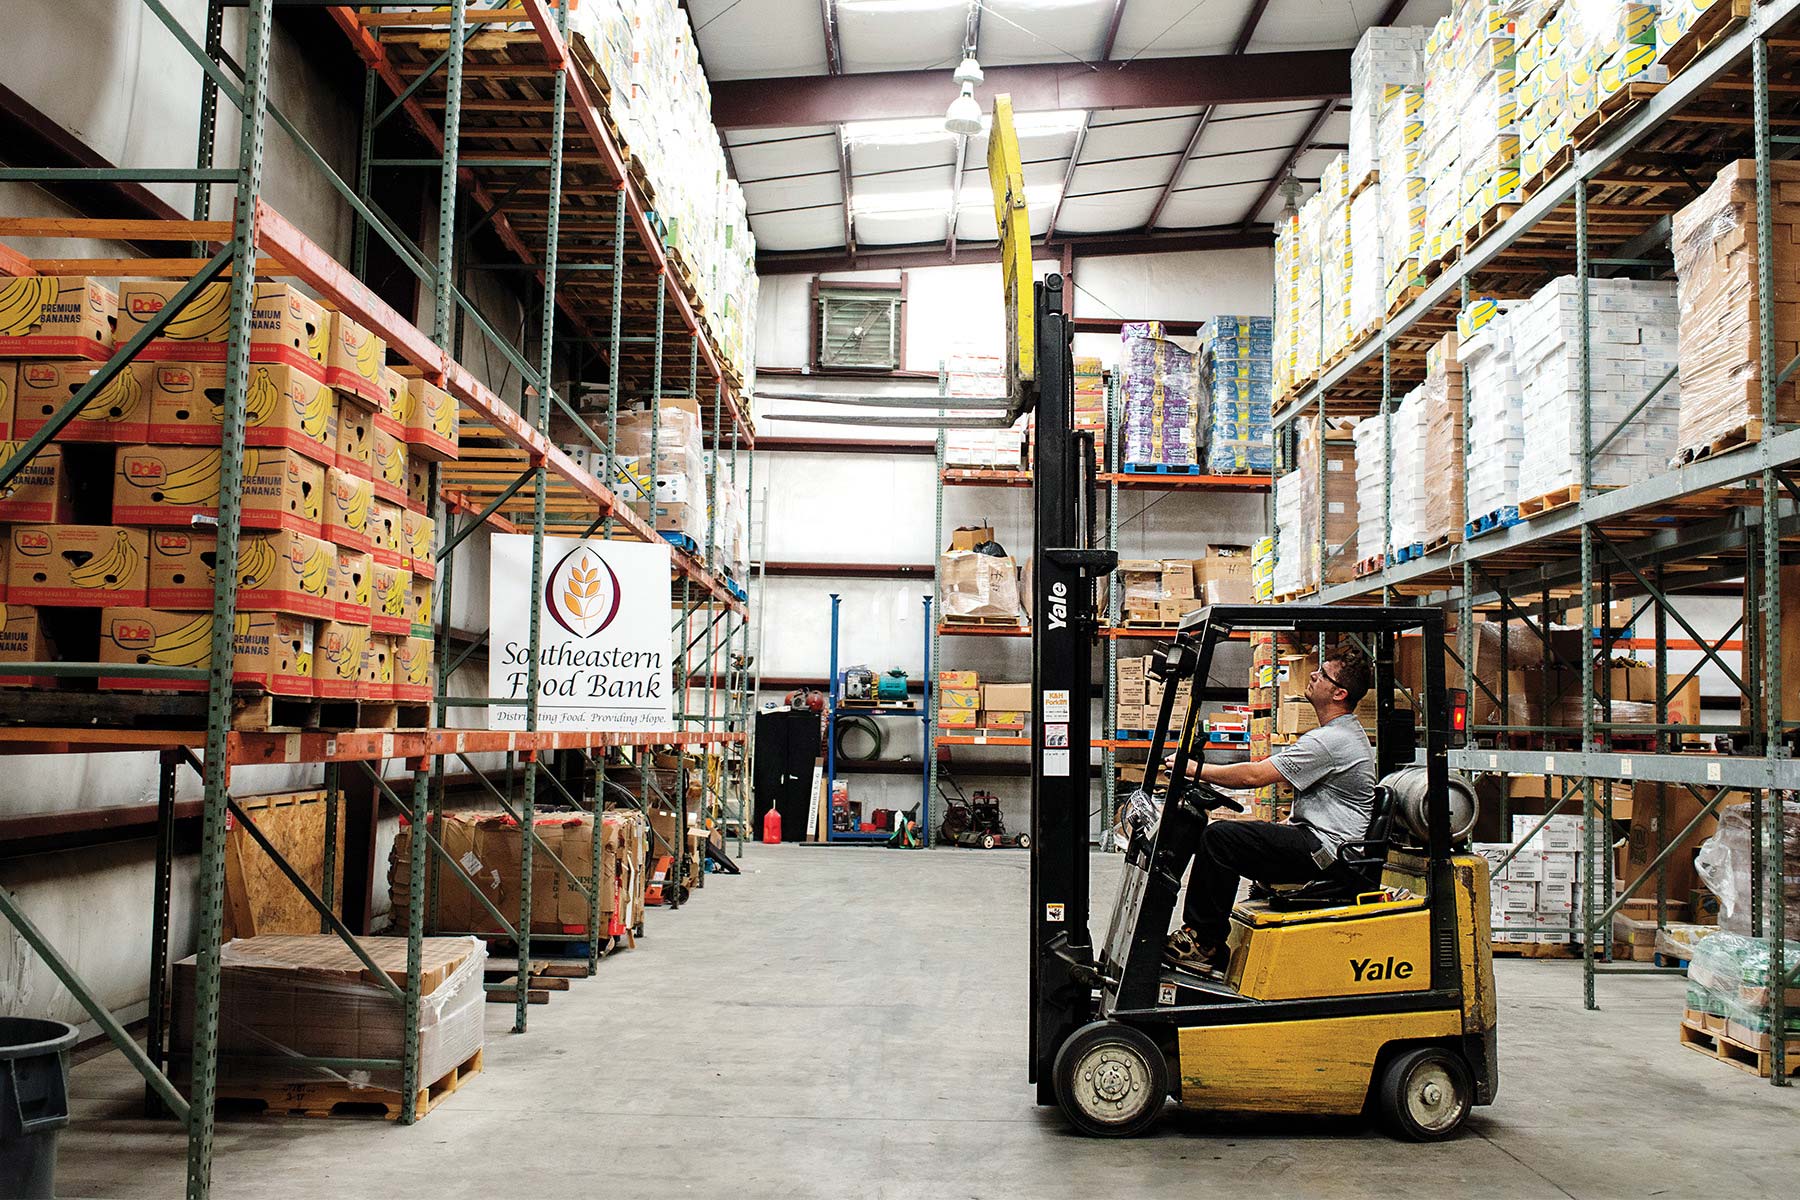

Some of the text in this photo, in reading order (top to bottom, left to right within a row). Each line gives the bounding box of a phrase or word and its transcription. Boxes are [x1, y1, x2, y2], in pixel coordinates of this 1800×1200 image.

[41, 303, 81, 313] PREMIUM
[132, 298, 163, 311] Dole
[40, 314, 81, 323] BANANAS
[252, 310, 281, 319] EMIUM
[251, 321, 281, 330] NANAS
[30, 368, 56, 379] Dole
[163, 371, 191, 382] Dole
[20, 466, 55, 475] REMIUM
[131, 462, 162, 475] Dole
[242, 476, 282, 485] PREMIUM
[242, 486, 282, 496] BANANAS
[21, 534, 49, 547] Dole
[161, 536, 188, 548] Dole
[1048, 581, 1067, 631] Yale
[0, 632, 29, 641] EMIUM
[119, 625, 151, 638] Dole
[234, 634, 270, 645] REMIUM
[0, 643, 29, 652] NANAS
[234, 645, 270, 656] ANANAS
[502, 641, 662, 669] Southeastern
[587, 672, 661, 699] Bank
[497, 711, 666, 724] Distriting Food. Providing Hope.
[1349, 956, 1413, 982] Yale
